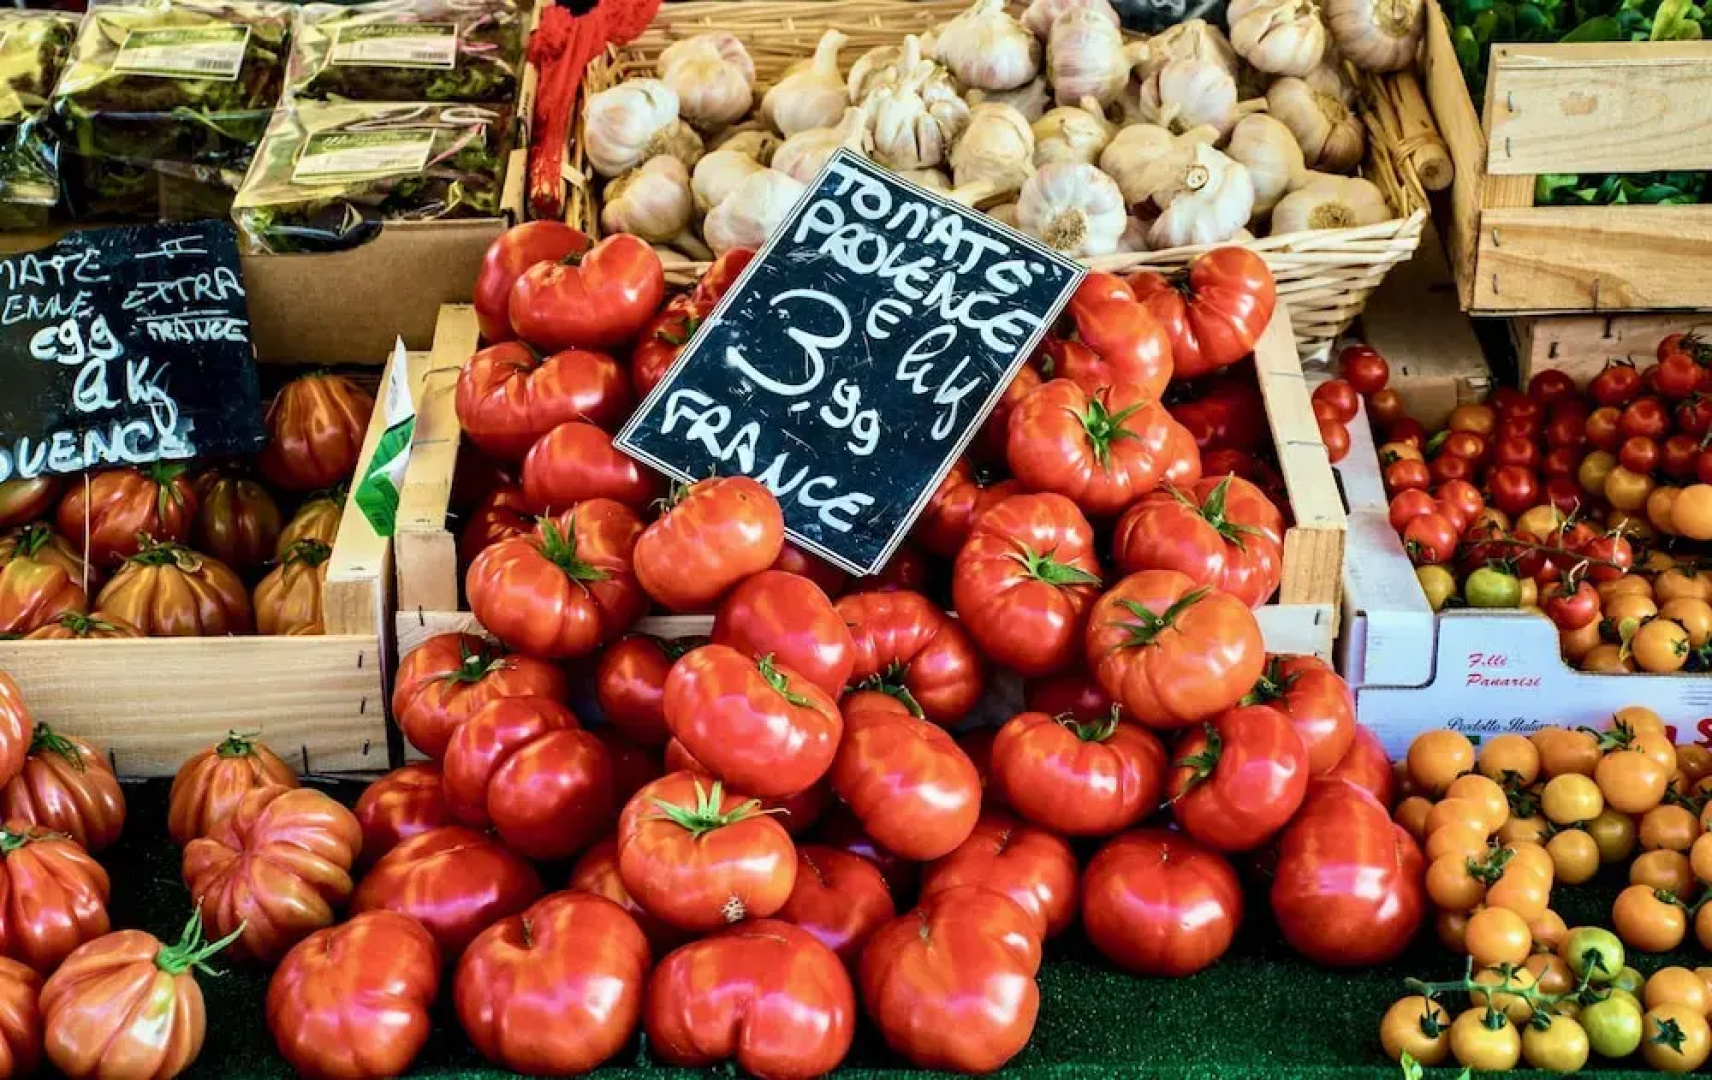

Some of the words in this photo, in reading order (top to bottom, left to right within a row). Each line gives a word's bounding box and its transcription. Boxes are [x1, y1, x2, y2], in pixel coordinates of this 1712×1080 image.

[121, 266, 246, 310] EXTRA
[794, 199, 1043, 353] PROVENCE
[661, 388, 876, 533] FRANCE
